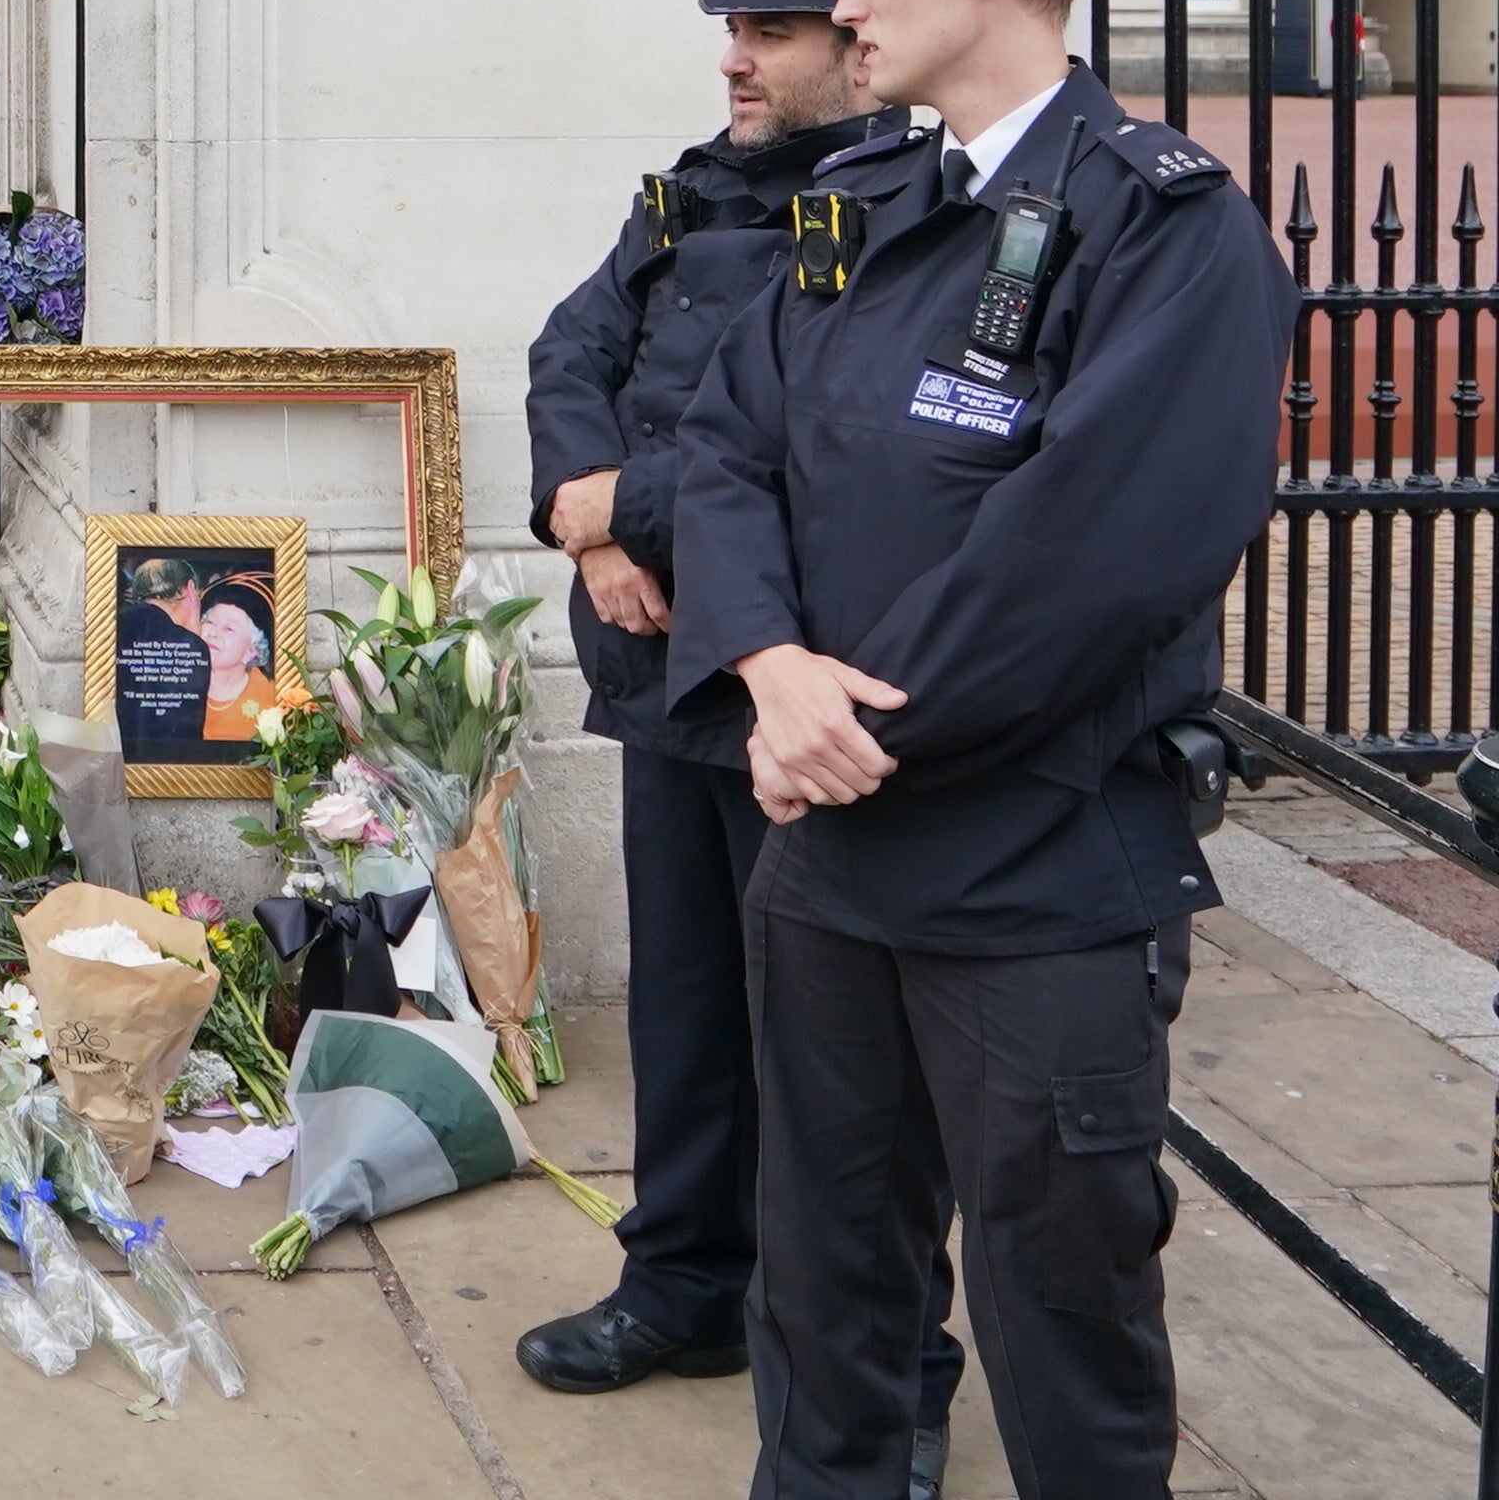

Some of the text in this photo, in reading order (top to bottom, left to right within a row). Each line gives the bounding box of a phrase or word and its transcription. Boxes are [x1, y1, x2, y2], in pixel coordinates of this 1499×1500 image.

[1156, 150, 1190, 165] EA
[963, 359, 1007, 381] STEWART
[956, 385, 1016, 405] METROPOLITAN
[960, 395, 1004, 411] POLICE
[910, 401, 1011, 436] POLICE OFFICER
[133, 641, 191, 650] Loved By Everyone
[174, 650, 202, 658] Everyone
[174, 659, 195, 667] Forget
[172, 667, 193, 675] Queen
